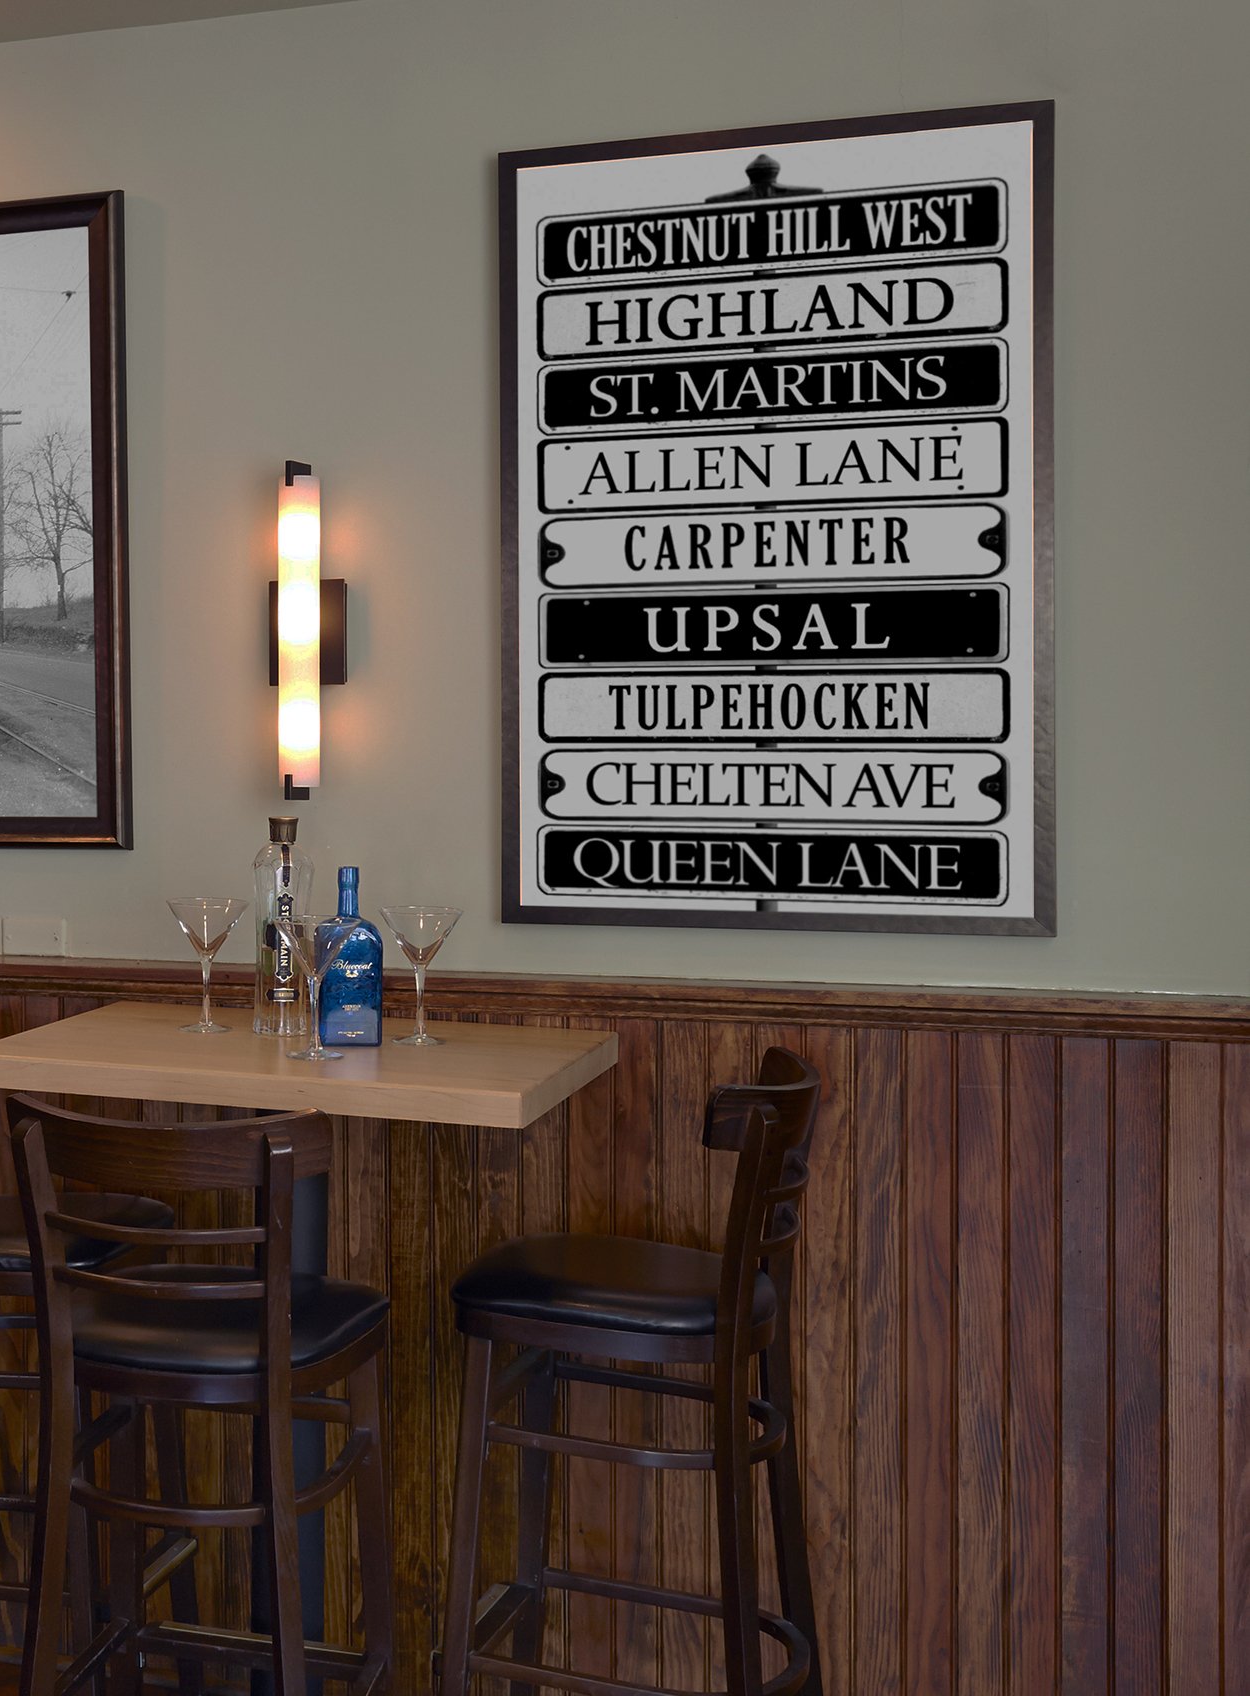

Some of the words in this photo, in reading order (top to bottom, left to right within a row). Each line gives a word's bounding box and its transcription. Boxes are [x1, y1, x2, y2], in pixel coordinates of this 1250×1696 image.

[567, 212, 755, 271] CHESTNUT
[767, 205, 850, 256] HILL
[862, 194, 972, 249] WEST
[585, 278, 954, 346] HIGHLAND
[590, 373, 659, 417] ST.
[676, 356, 946, 412] MARTINS
[579, 444, 774, 495] ALLEN
[795, 436, 963, 486] LANE
[625, 517, 910, 571] CARPENTER
[643, 603, 890, 652] UPSAL
[609, 683, 930, 730] TULPEHOCKEN
[586, 762, 836, 807] CHELTEN
[842, 763, 955, 808] AVE
[574, 838, 781, 887] QUEEN
[798, 843, 962, 889] LANE
[331, 959, 373, 969] Bluecoat
